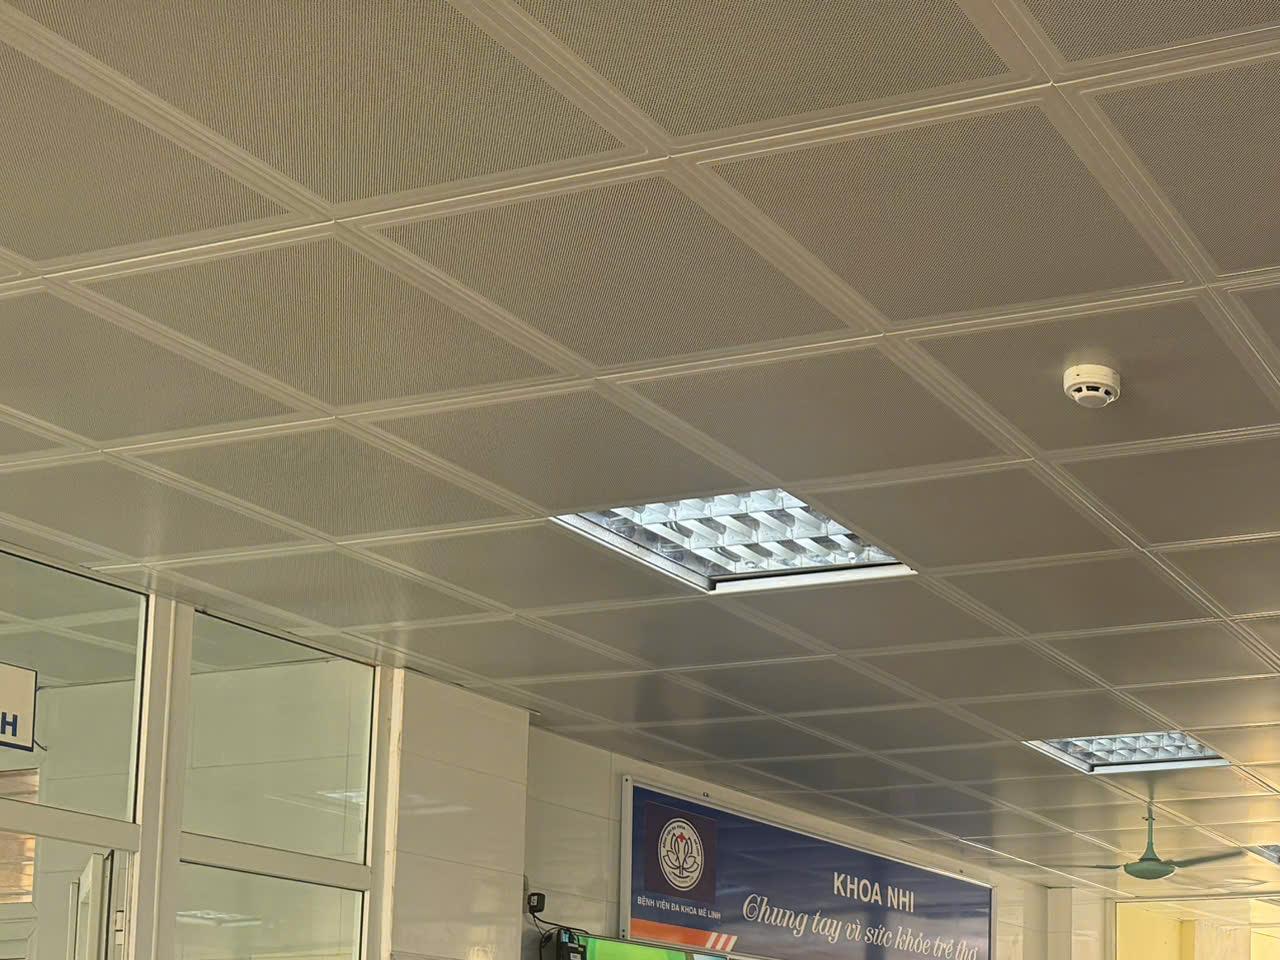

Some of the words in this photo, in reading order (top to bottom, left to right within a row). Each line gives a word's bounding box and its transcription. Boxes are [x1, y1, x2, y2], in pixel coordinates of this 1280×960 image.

[637, 896, 655, 907] BỆNH
[656, 900, 670, 910] VIỆN
[671, 902, 680, 912] ĐA
[680, 905, 697, 915] KHOA
[698, 907, 707, 917] MÊ
[708, 910, 721, 920] LINH
[833, 871, 883, 906] KHOA
[887, 885, 915, 913] NHI
[743, 893, 808, 937] Chung
[811, 909, 841, 944] tay
[845, 917, 863, 939] vì
[864, 921, 893, 948] sức
[894, 926, 931, 955] khỏe
[933, 934, 955, 960] trẻ
